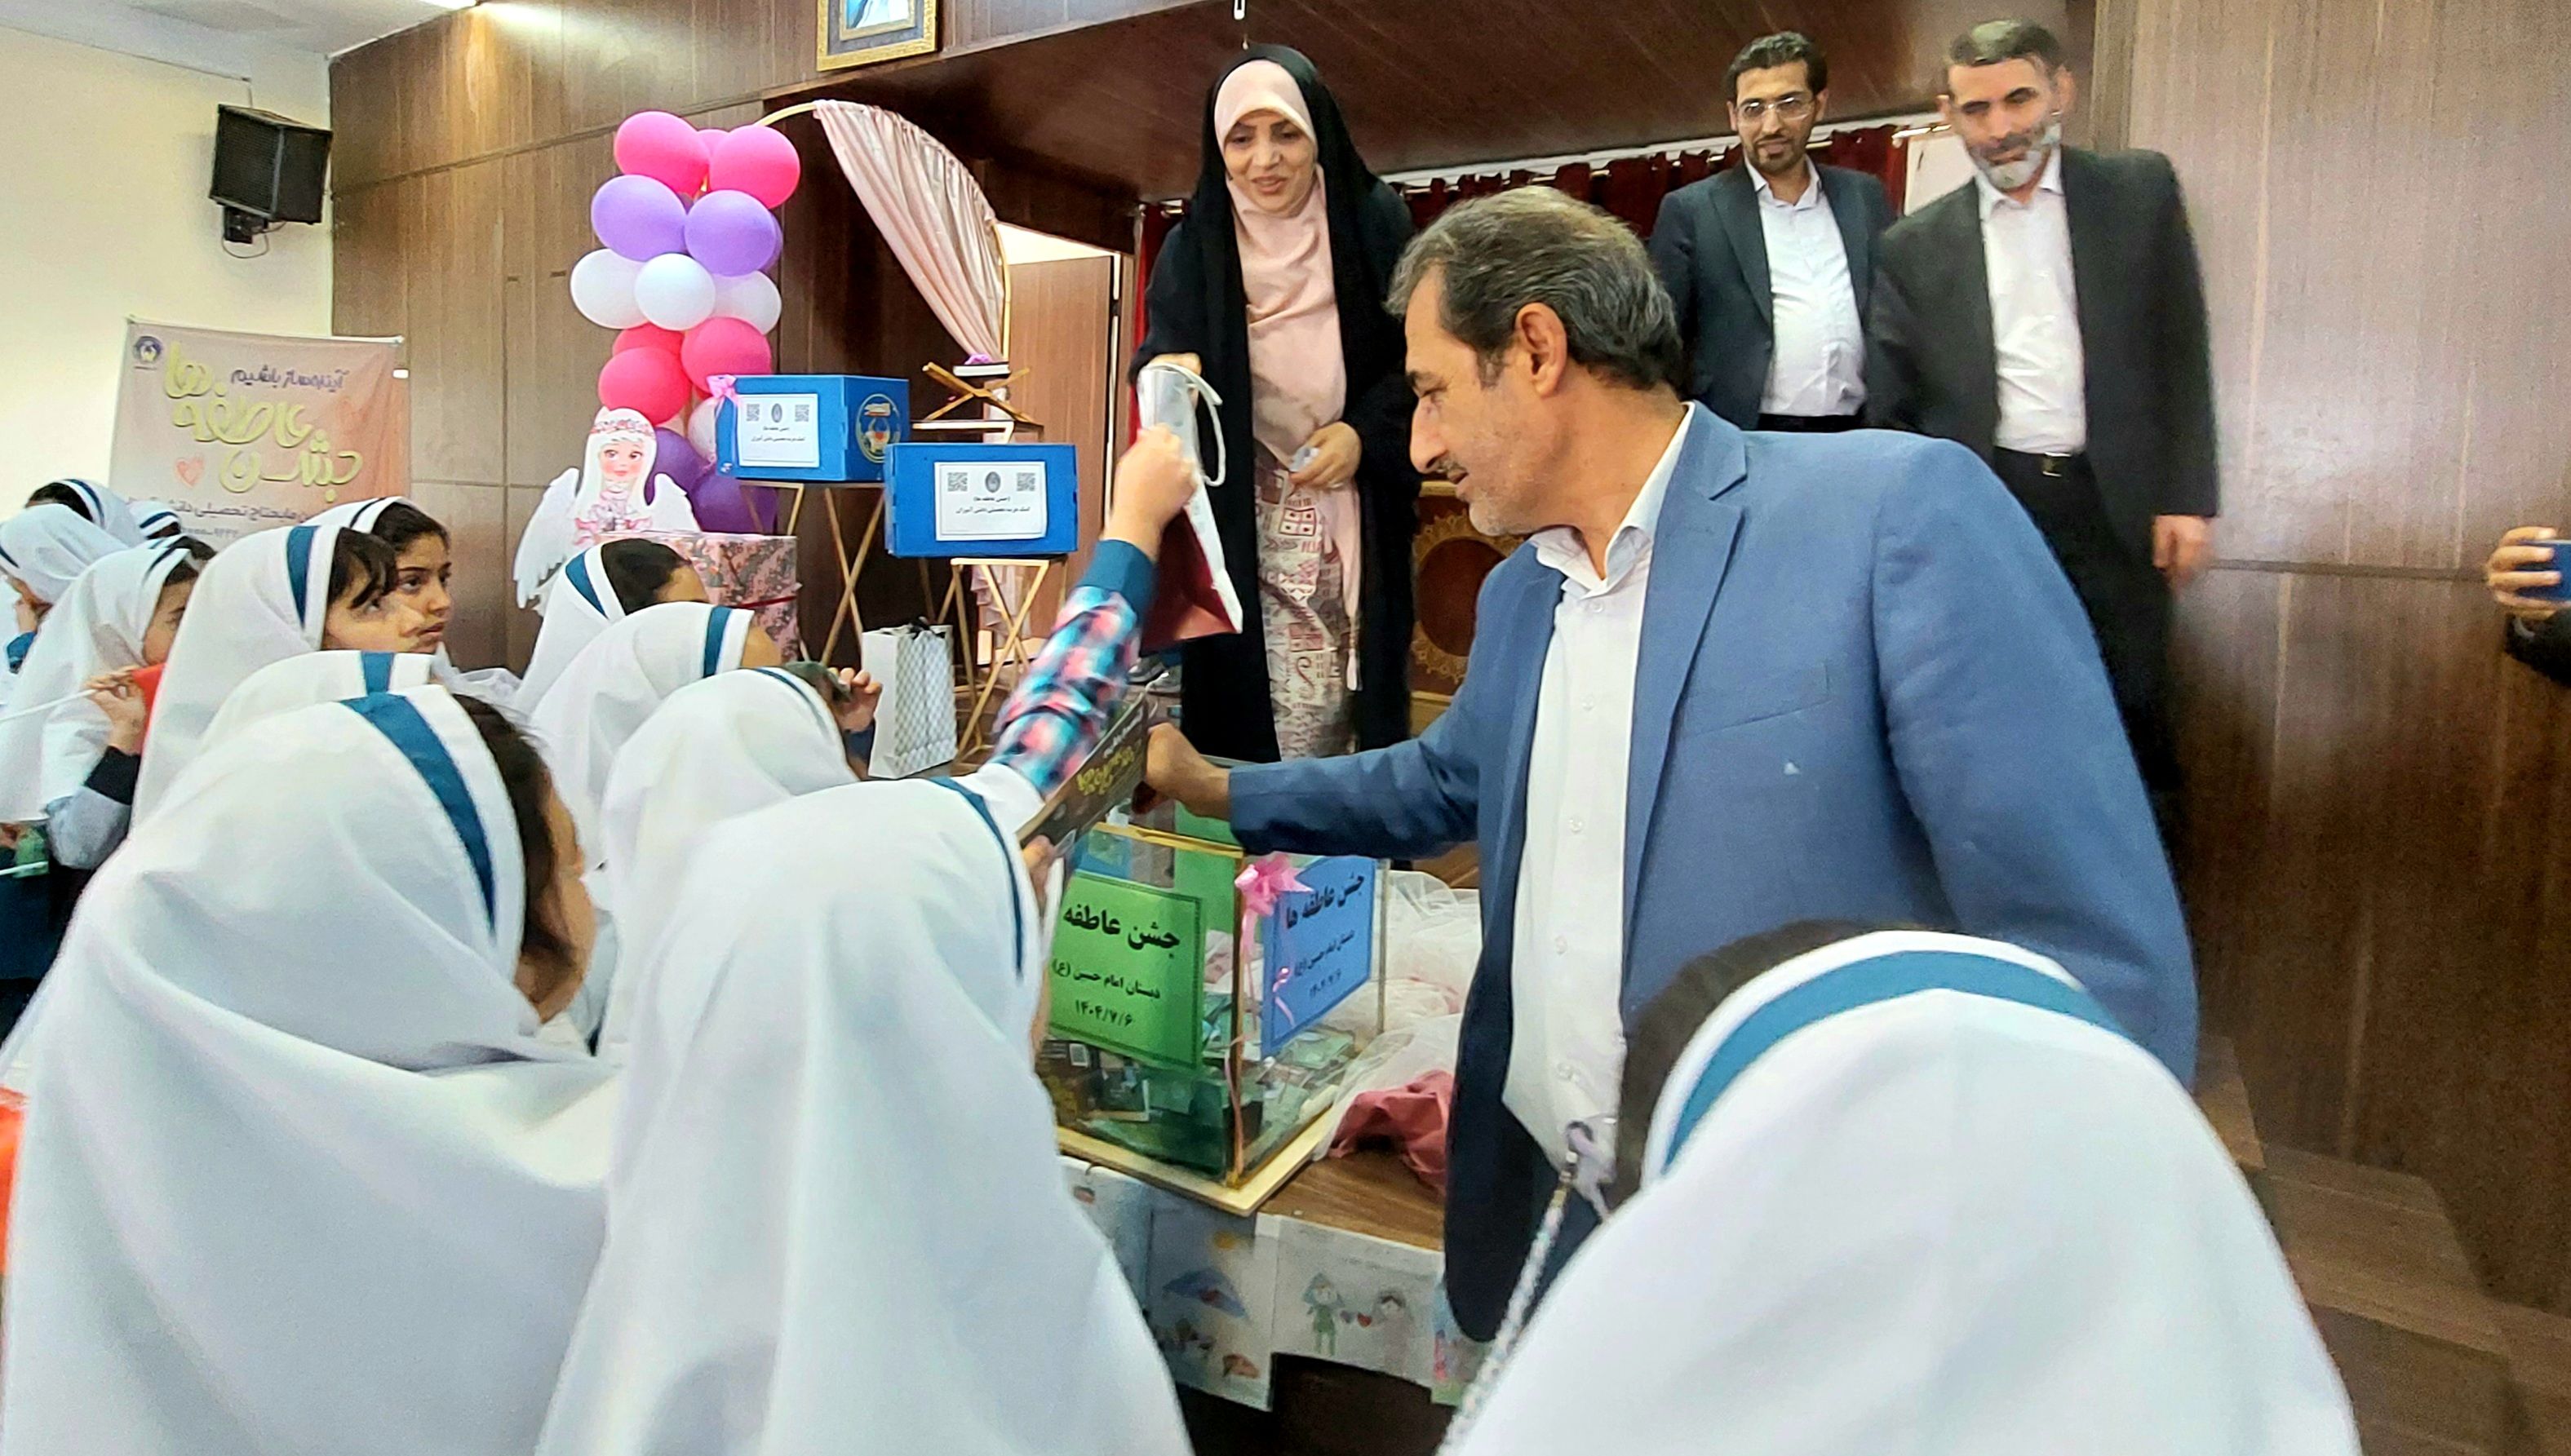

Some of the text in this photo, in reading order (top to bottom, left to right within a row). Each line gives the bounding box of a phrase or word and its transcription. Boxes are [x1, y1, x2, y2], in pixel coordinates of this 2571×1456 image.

[230, 364, 281, 389] باشیم
[172, 381, 313, 449] عاطفه
[219, 429, 364, 504] جشن
[1286, 871, 1365, 929] جشن عاطفه ها
[1062, 903, 1181, 959] جشن عاطفه
[1052, 958, 1071, 978] (ع)
[1103, 974, 1124, 989] امام
[1125, 980, 1161, 1002] دبستان
